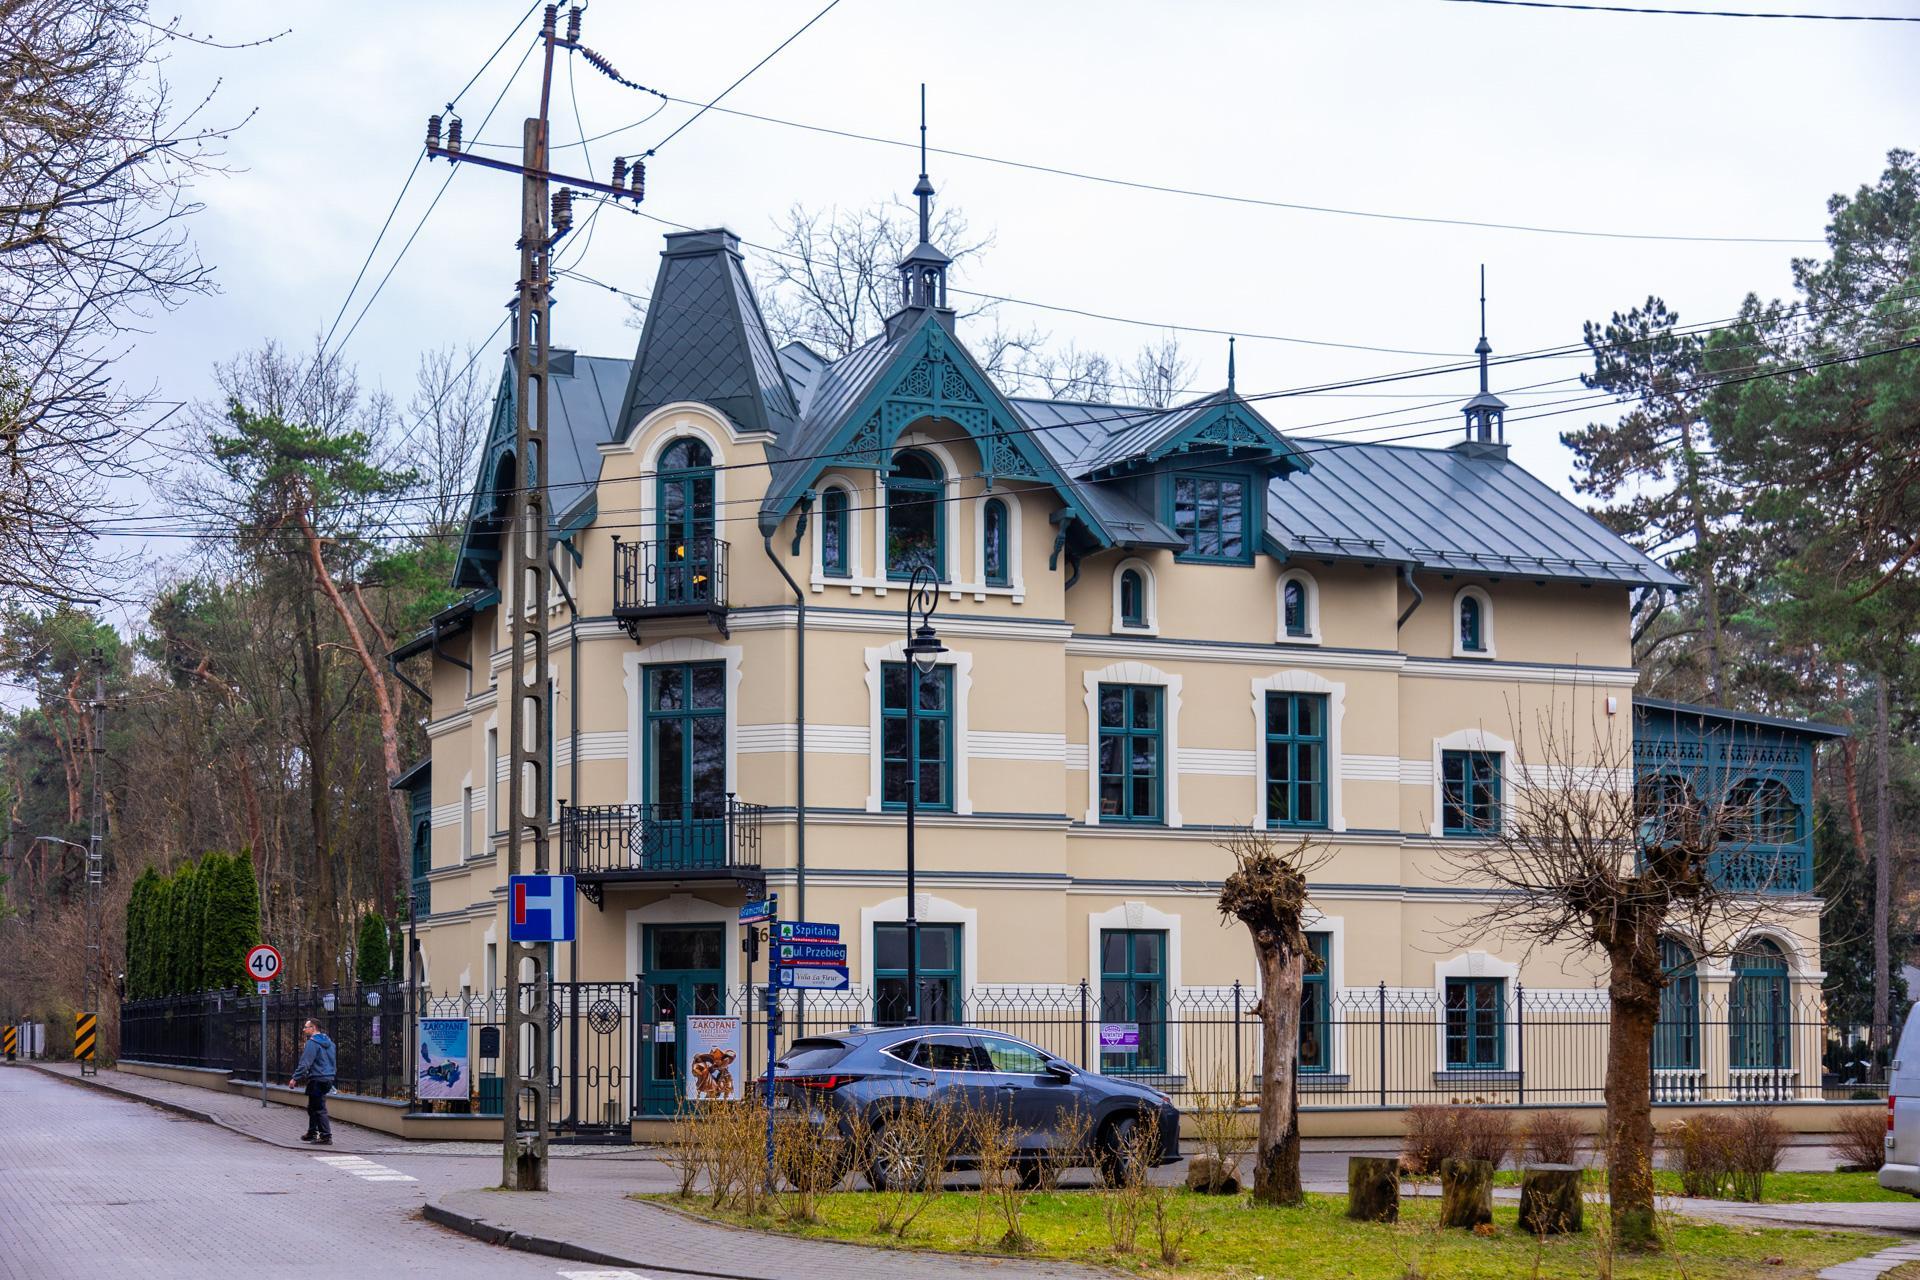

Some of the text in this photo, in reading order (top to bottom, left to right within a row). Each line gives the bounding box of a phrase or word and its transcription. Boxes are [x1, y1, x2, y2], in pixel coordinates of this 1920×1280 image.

[758, 928, 768, 942] 6
[795, 924, 837, 937] Szpitalna
[793, 946, 846, 960] ul. Przebieg
[252, 954, 277, 972] 40
[423, 1022, 465, 1031] ZAKOPANE
[693, 1021, 736, 1029] ZAKOPANE
